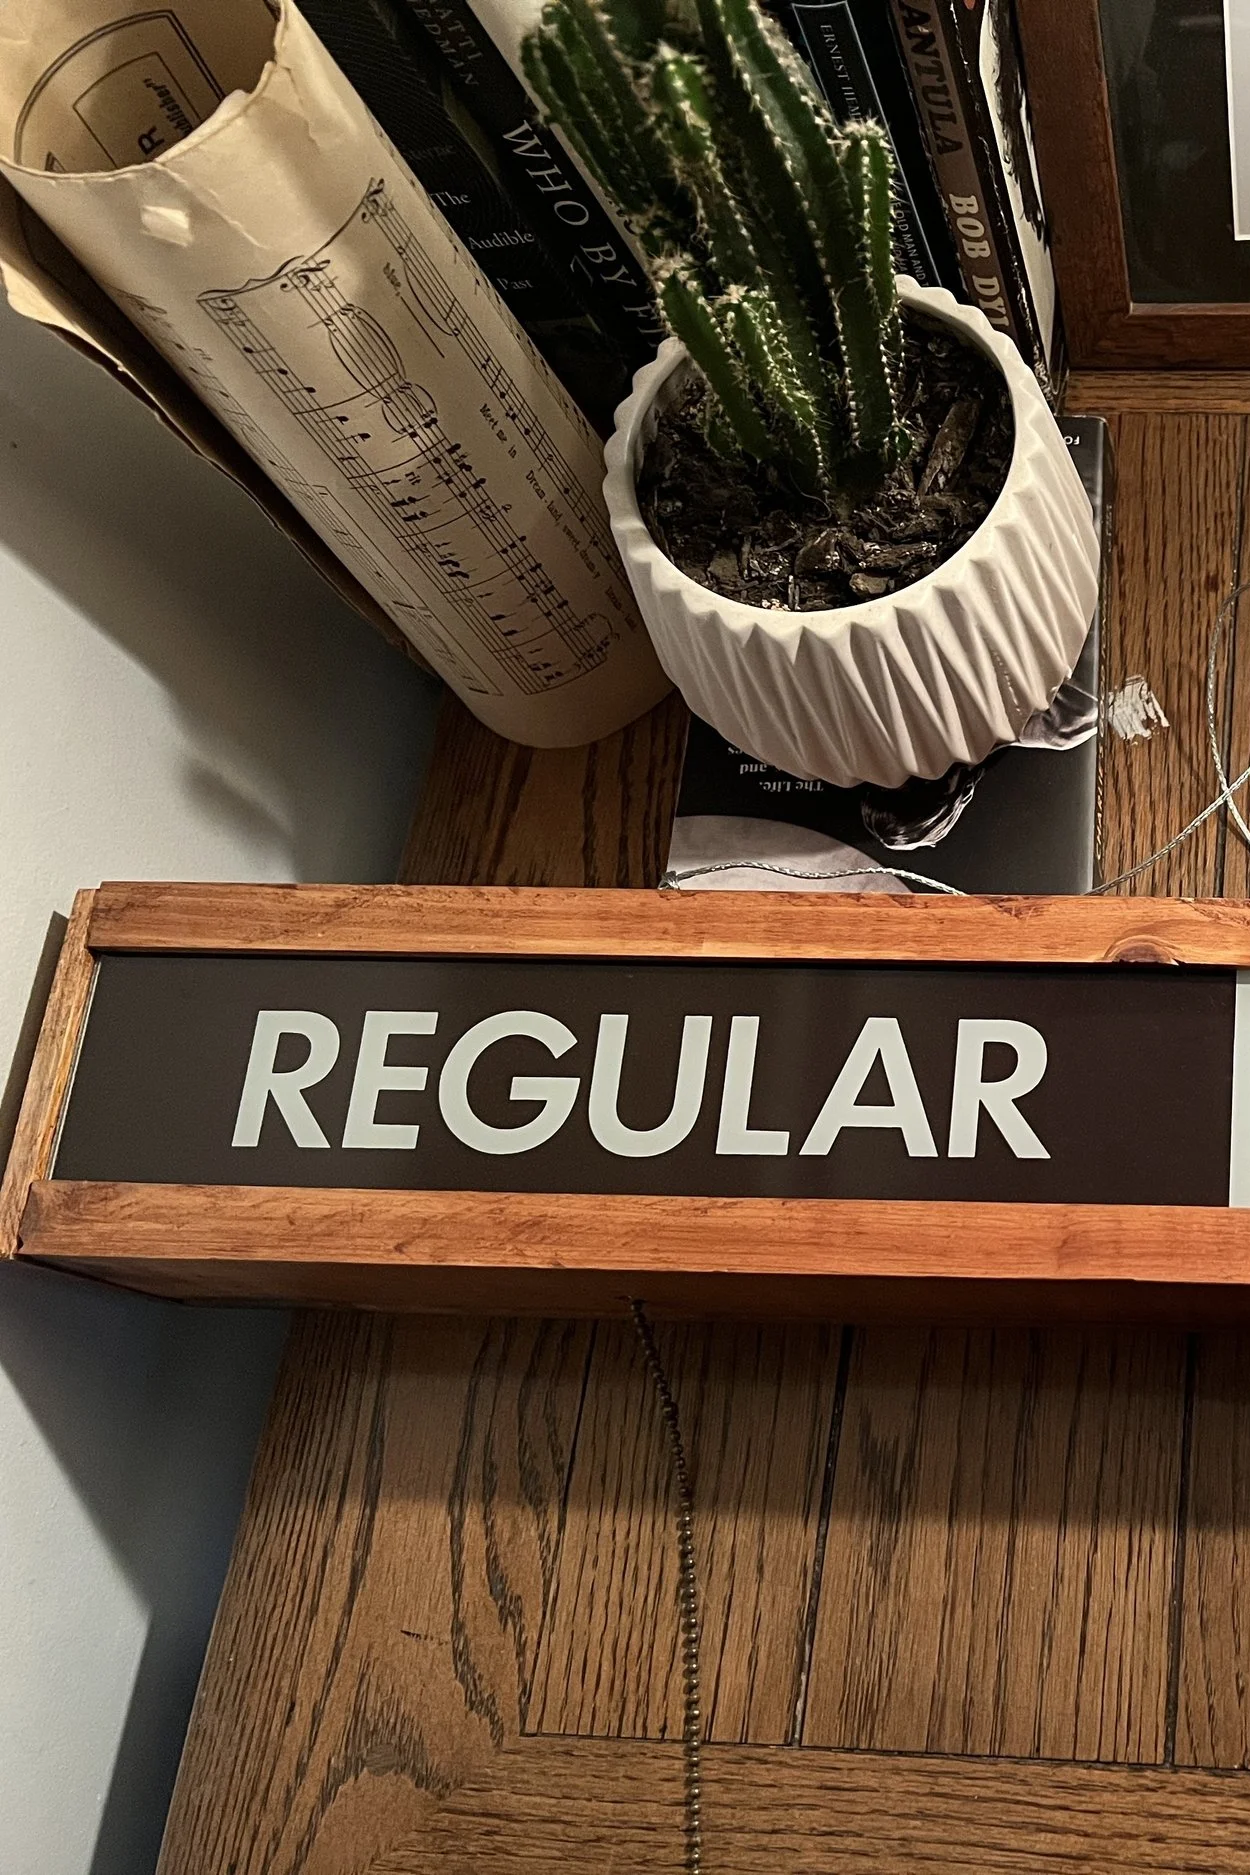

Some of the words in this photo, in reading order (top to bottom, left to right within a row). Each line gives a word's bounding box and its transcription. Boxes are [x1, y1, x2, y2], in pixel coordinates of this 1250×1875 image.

[434, 0, 484, 60] ATTI
[407, 0, 480, 87] EDMAN
[820, 24, 850, 81] ERNEST
[841, 86, 863, 120] HEM
[138, 126, 165, 155] R
[898, 0, 964, 156] ANTULA
[949, 193, 991, 259] BOB
[430, 191, 472, 207] The
[896, 210, 910, 233] OLD
[468, 229, 536, 250] Audible
[502, 119, 590, 226] WHO
[579, 241, 638, 288] BY
[622, 301, 666, 349] FI
[902, 234, 919, 258] MAN
[911, 259, 927, 281] AND
[496, 277, 534, 291] Past
[1063, 435, 1080, 446] FO
[739, 764, 768, 775] and
[795, 781, 824, 792] The
[233, 1012, 1050, 1159] REGULAR
